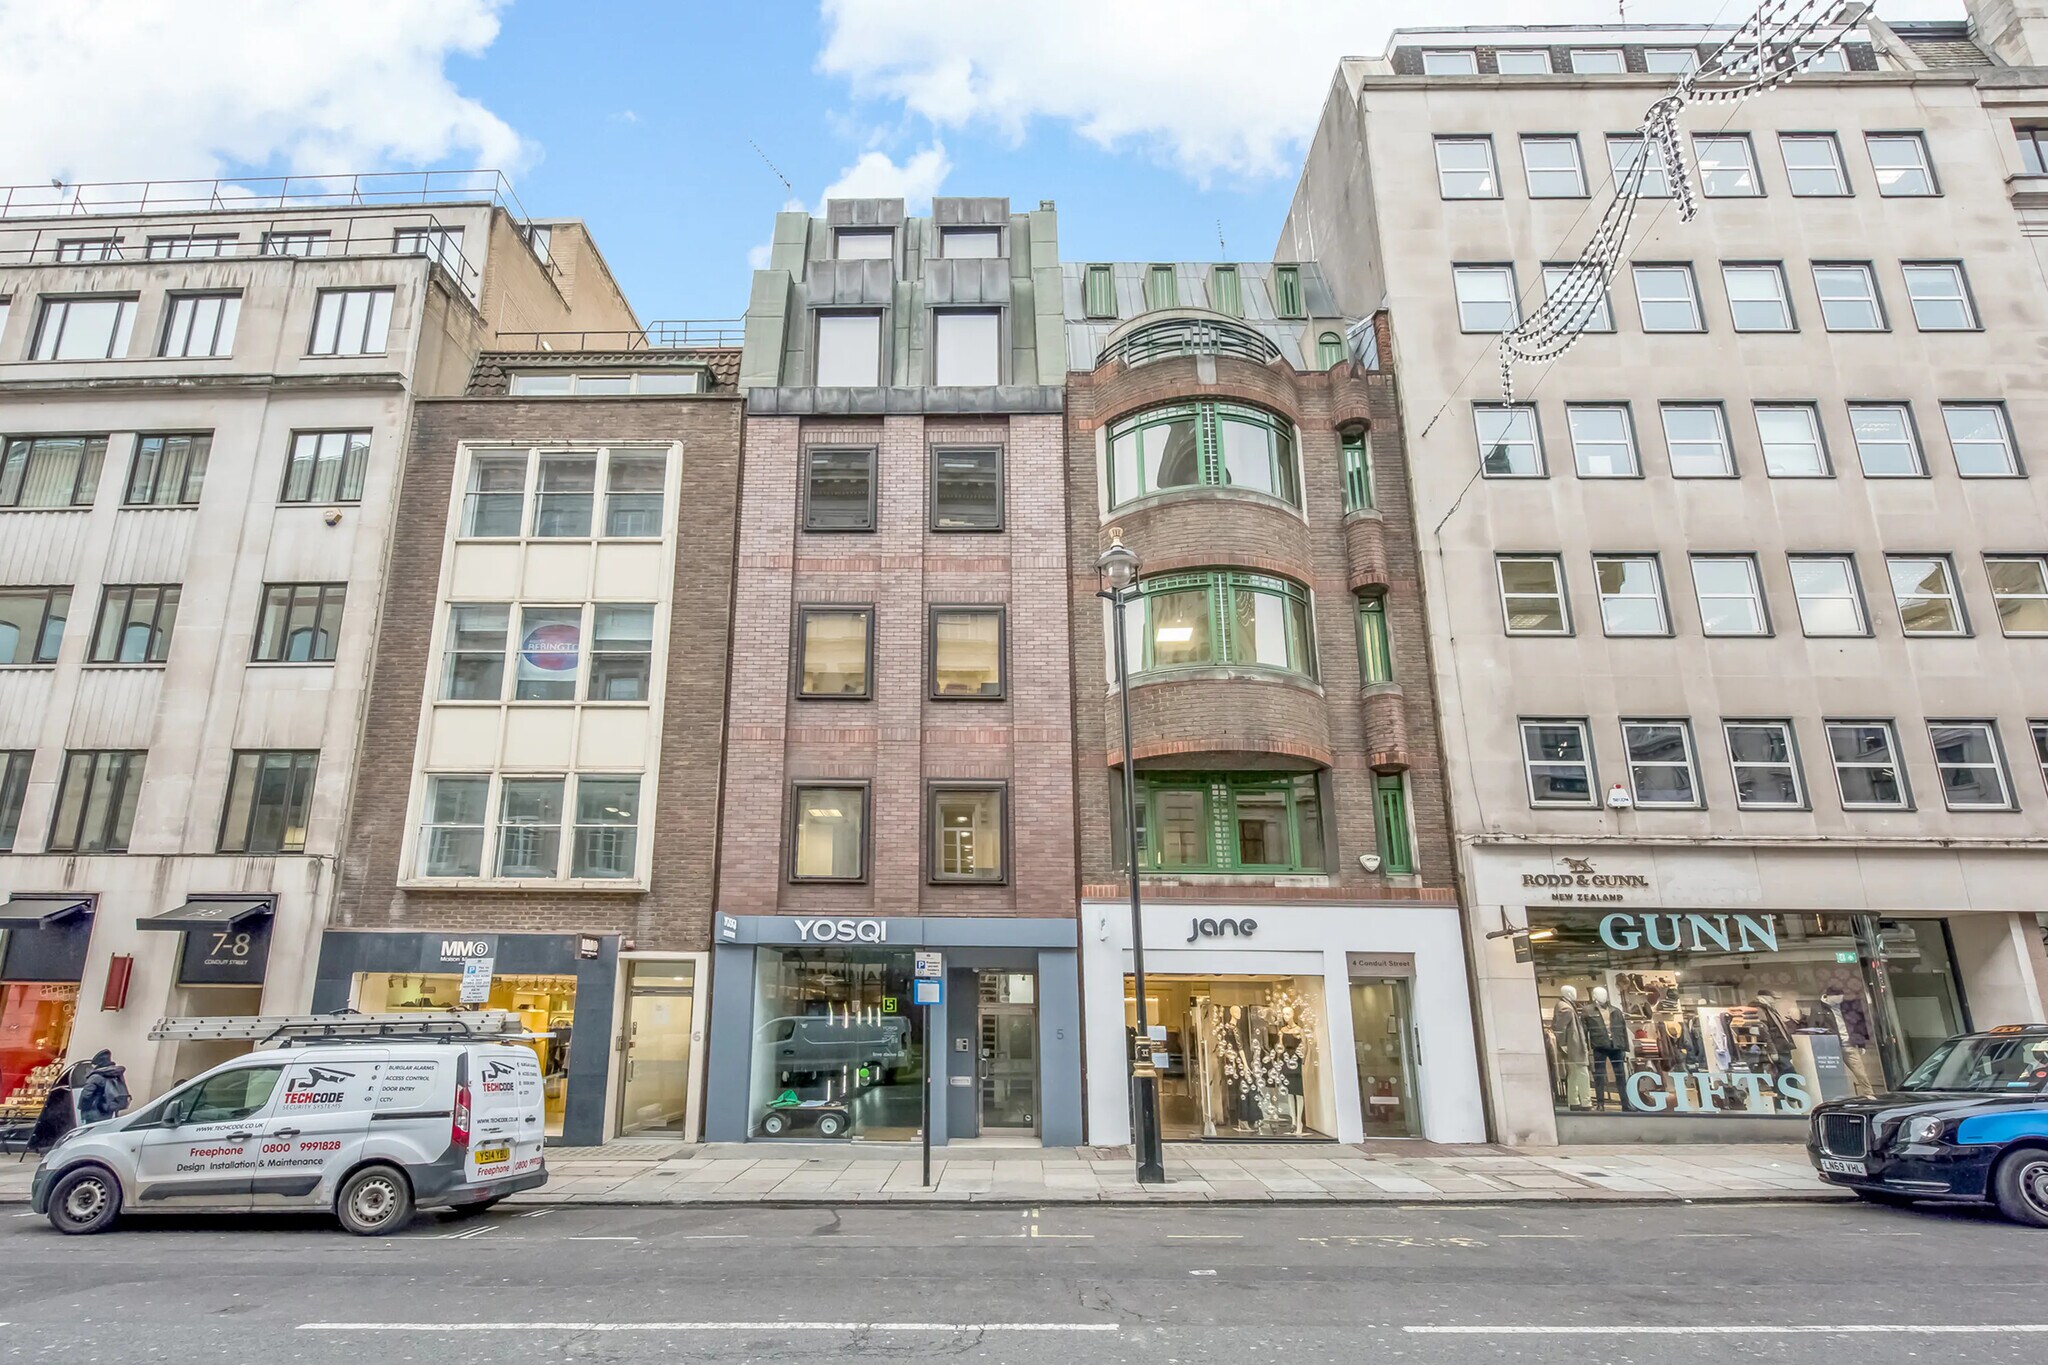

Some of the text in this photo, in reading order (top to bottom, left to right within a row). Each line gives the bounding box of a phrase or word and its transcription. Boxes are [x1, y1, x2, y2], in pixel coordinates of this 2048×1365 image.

[1522, 874, 1574, 887] RODD
[1576, 874, 1591, 887] &
[1552, 893, 1624, 902] NEW ZEALAND
[794, 919, 887, 944] YOSQI
[1187, 917, 1259, 943] jane
[1599, 913, 1779, 952] GUNN
[211, 933, 251, 956] 7-8
[692, 1031, 701, 1042] 6
[1056, 1028, 1064, 1040] 5
[483, 1082, 514, 1092] TECHCODE
[1626, 1071, 1812, 1114] GIFTS
[284, 1091, 344, 1104] TECHCODE
[190, 1147, 244, 1159] Freephone
[262, 1141, 341, 1154] 0800 9991828
[176, 1158, 324, 1172] Design Installation & Maintenance
[477, 1165, 510, 1176] Freephone
[1824, 1162, 1863, 1174] LN69 VHL
